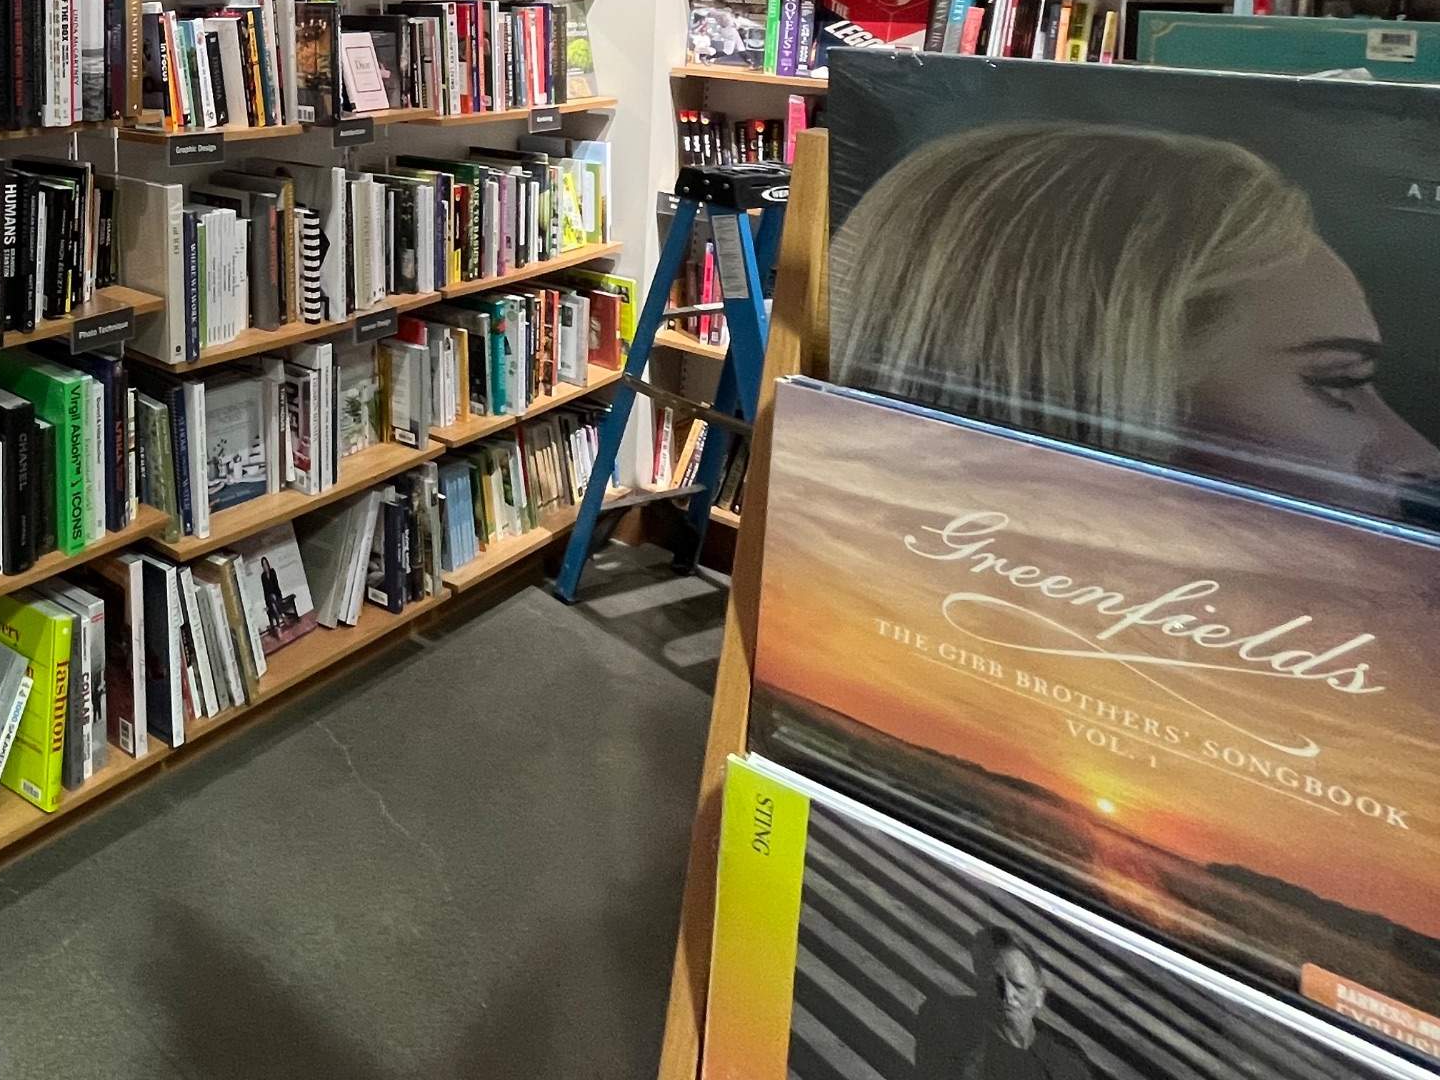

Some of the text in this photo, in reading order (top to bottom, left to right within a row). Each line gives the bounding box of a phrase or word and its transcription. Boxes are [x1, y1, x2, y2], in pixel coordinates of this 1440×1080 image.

[60, 5, 69, 23] THE
[60, 24, 69, 42] BOX
[159, 42, 169, 83] In Focus
[197, 141, 218, 153] Design
[3, 183, 18, 245] HUMANS
[472, 177, 480, 206] BACK
[189, 242, 198, 323] WHERE WE WORK
[78, 327, 98, 340] Photo
[17, 432, 27, 492] CHANEL
[68, 383, 83, 541] Virgil ICONS
[904, 511, 1386, 696] Greenfields
[872, 616, 1411, 831] THE GIBB BROTHERS' SONGBOOK
[1064, 718, 1160, 773] VOL. 1
[750, 793, 776, 857] STING
